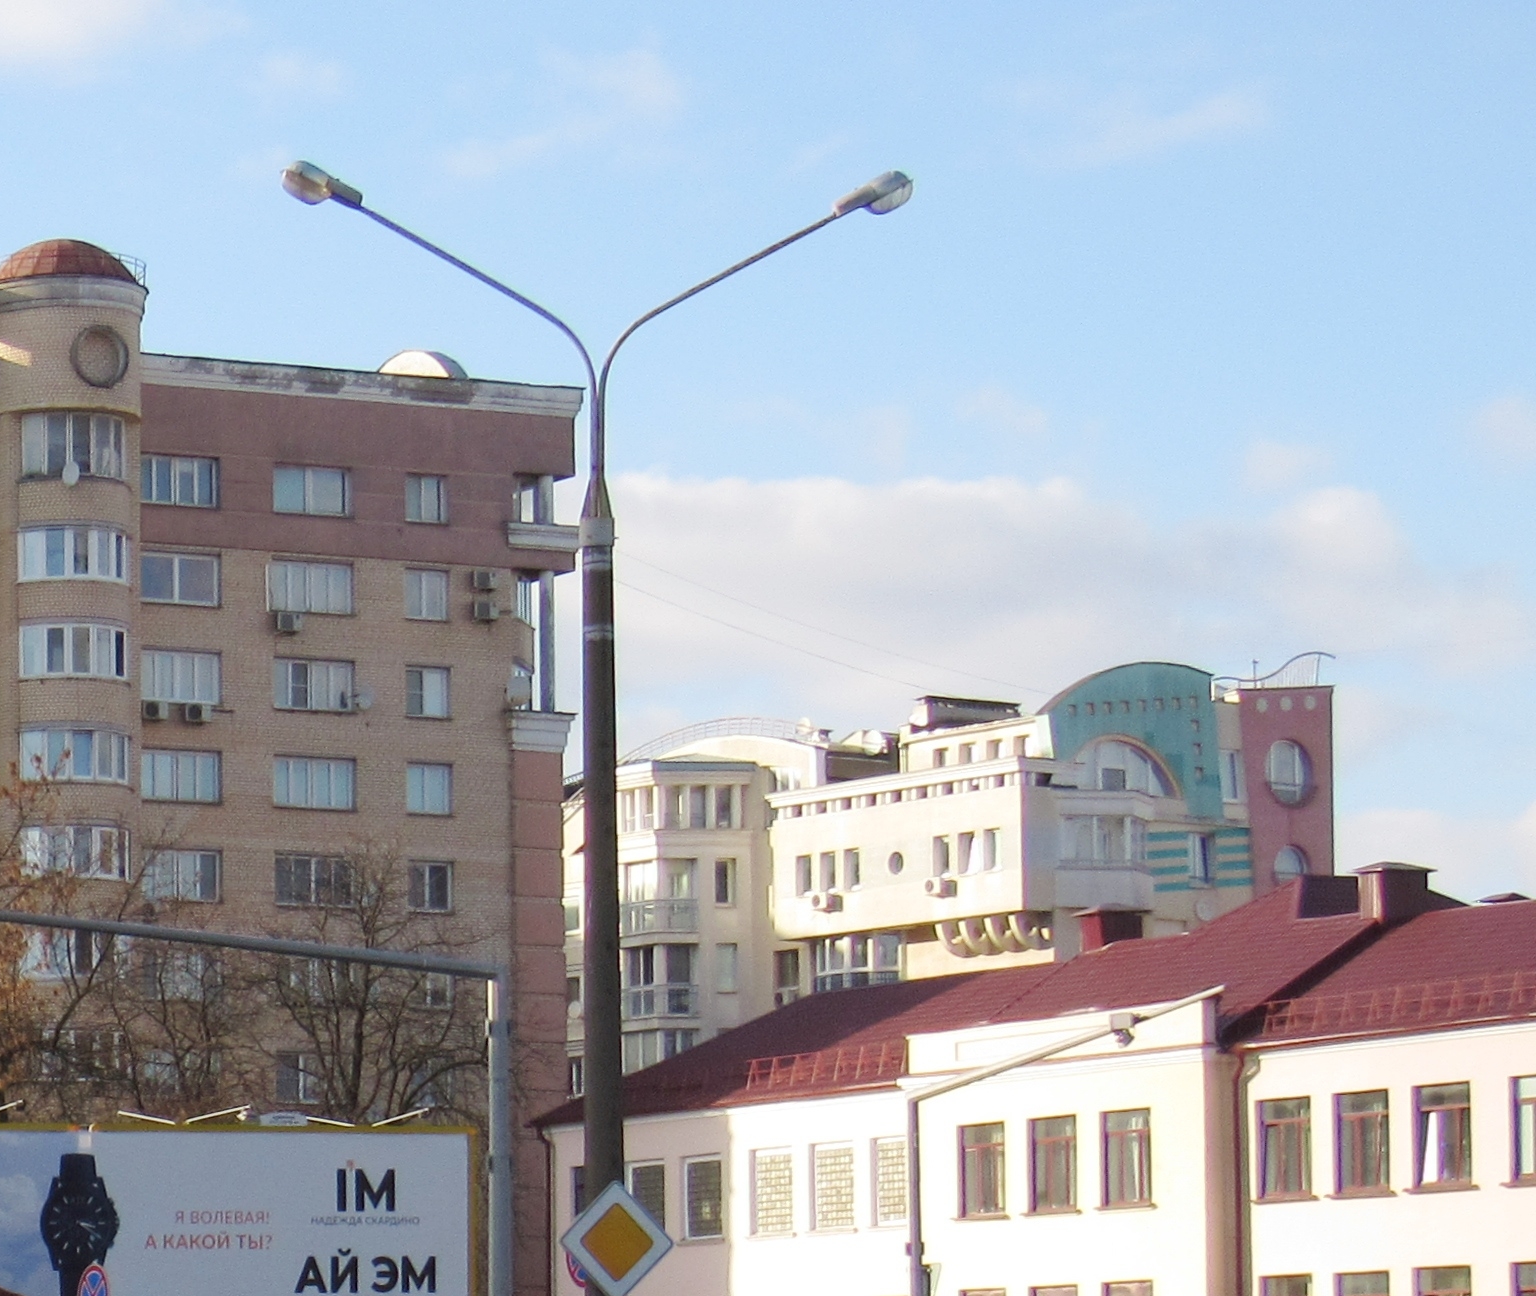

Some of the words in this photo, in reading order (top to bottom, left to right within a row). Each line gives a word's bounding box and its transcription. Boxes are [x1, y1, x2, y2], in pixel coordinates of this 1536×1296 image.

[175, 1210, 185, 1224] Я
[190, 1210, 270, 1225] ВОЛЕВАЯ!
[310, 1216, 363, 1227] НАДЕЖДА
[364, 1216, 421, 1227] СКАРДИНО
[144, 1233, 158, 1250] А
[162, 1230, 231, 1250] КАКОЙ
[236, 1233, 273, 1250] ТЫ?
[294, 1248, 359, 1294] АЙ
[371, 1255, 437, 1294] ЭМ
